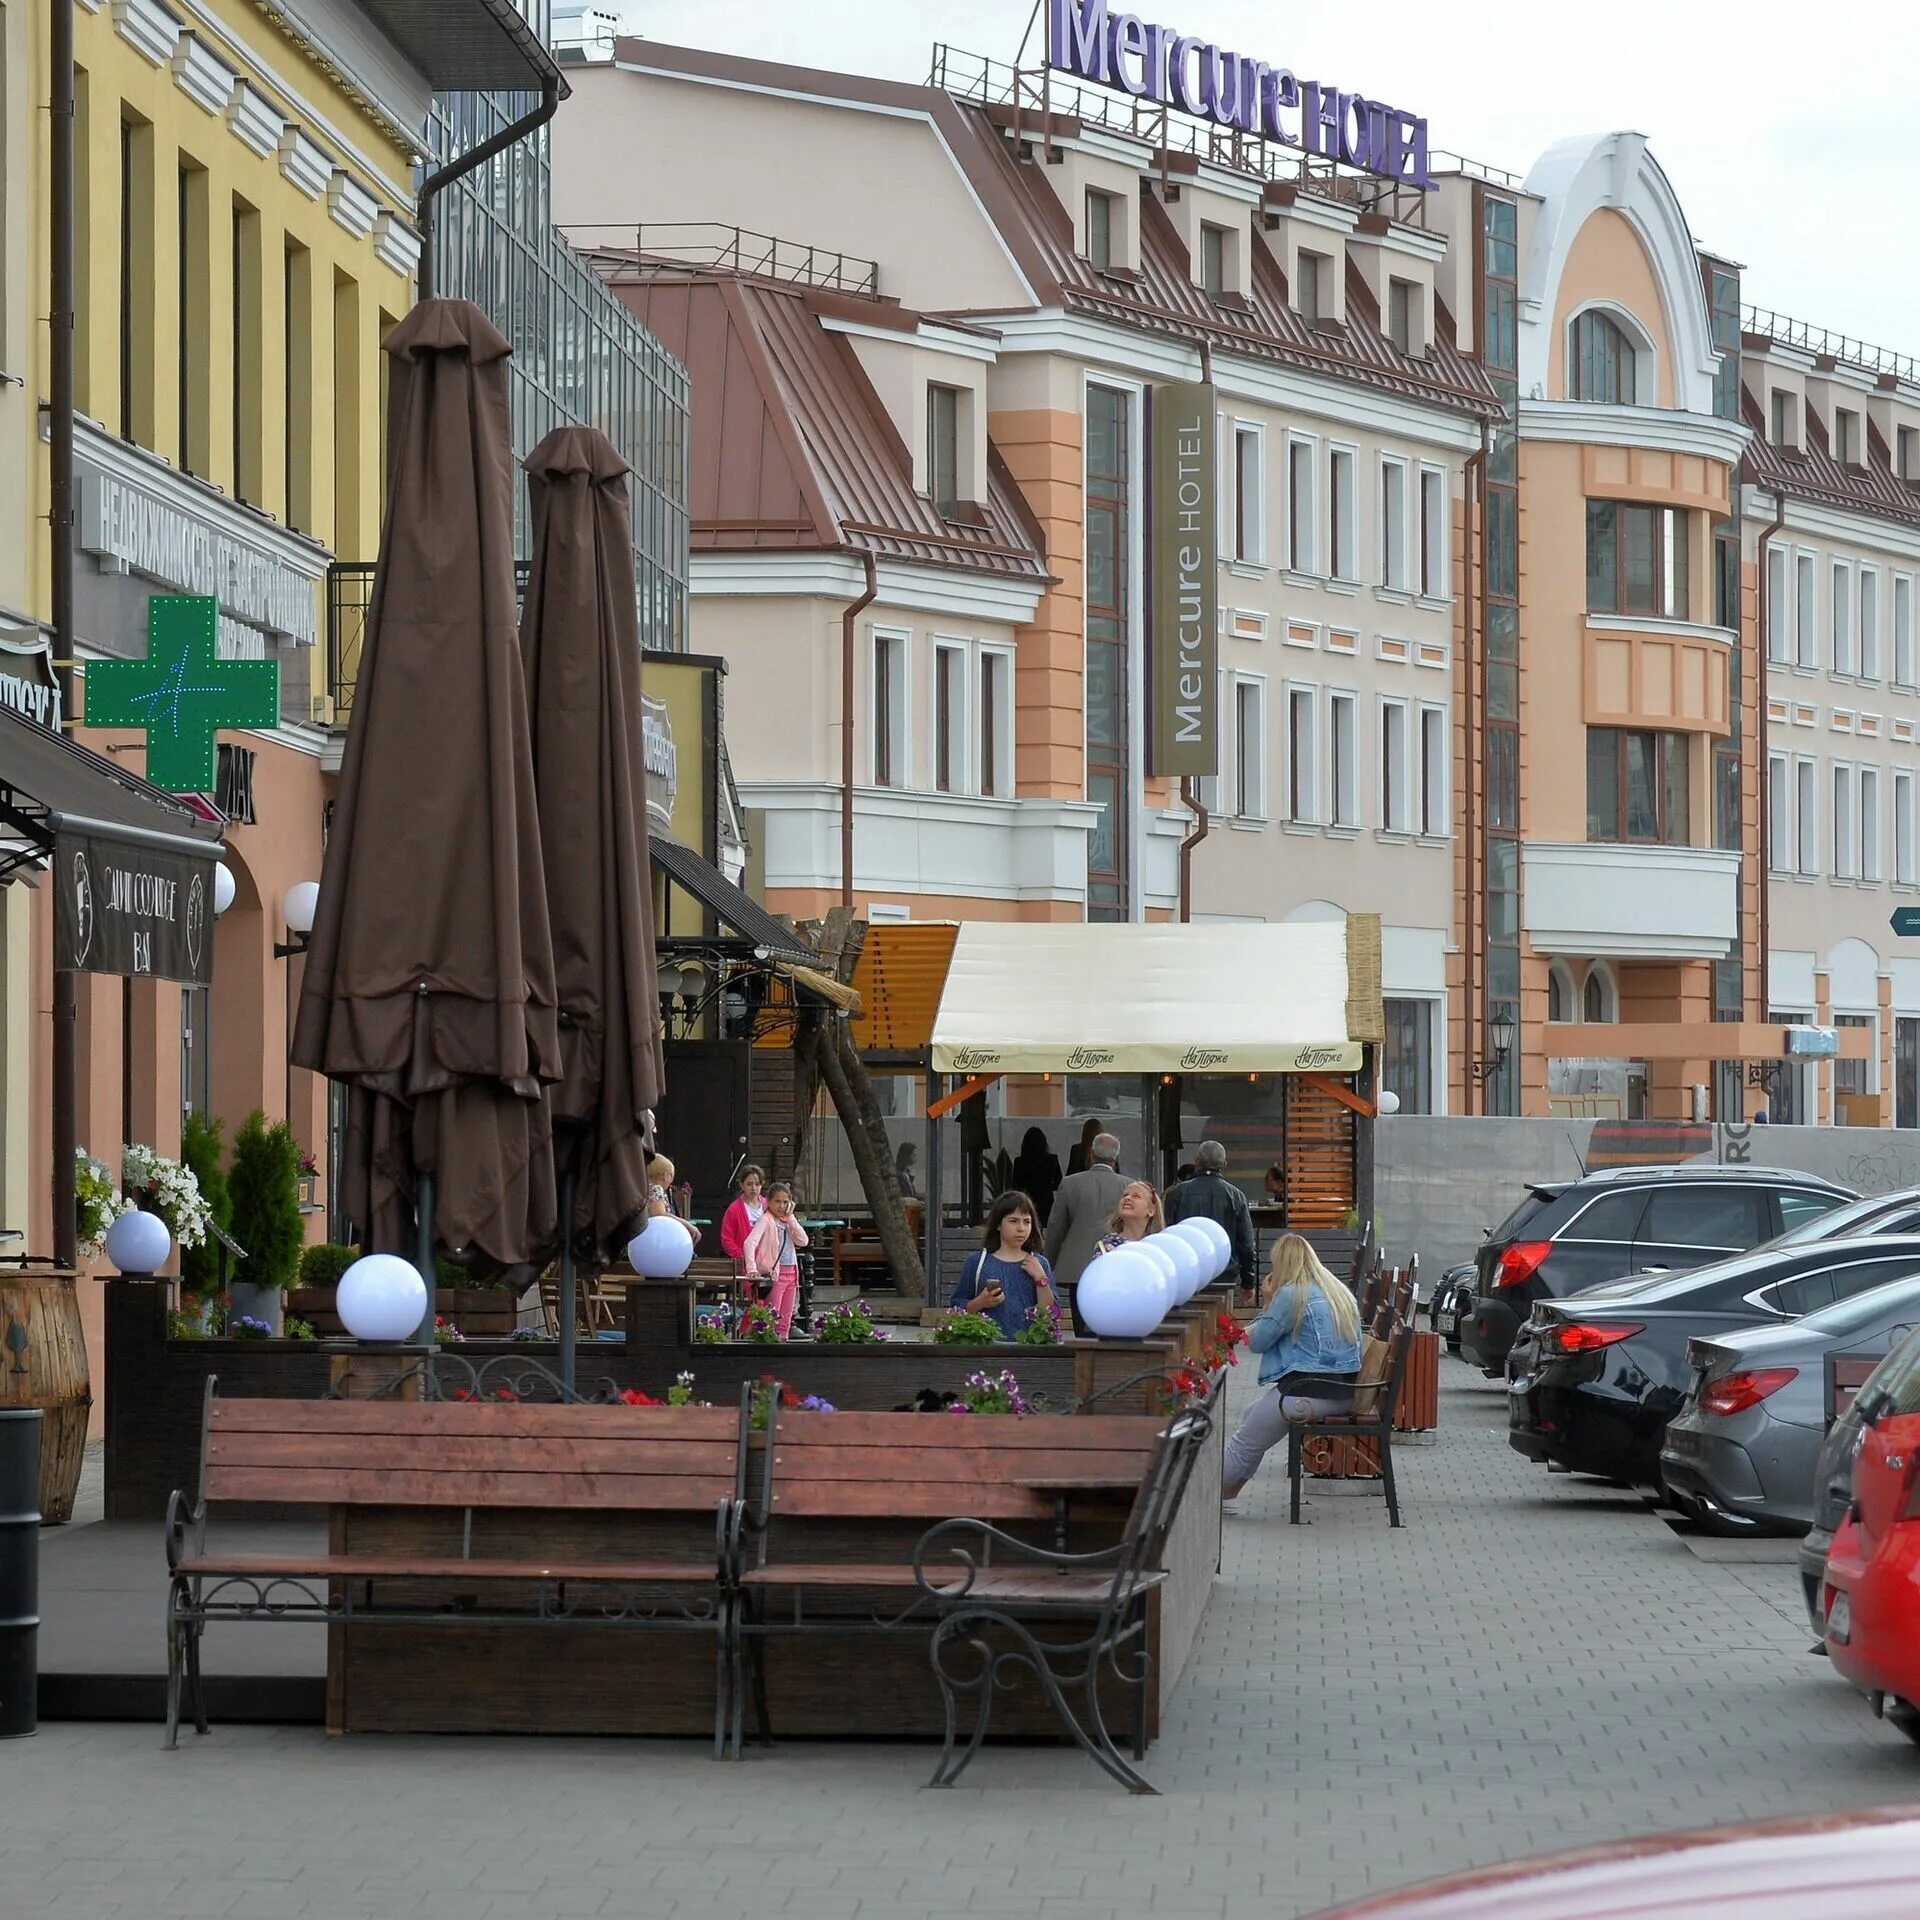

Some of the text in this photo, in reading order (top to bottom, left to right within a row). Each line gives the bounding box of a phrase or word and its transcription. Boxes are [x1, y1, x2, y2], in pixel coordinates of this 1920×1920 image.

[1051, 0, 1299, 144] Mercure
[98, 475, 214, 595] НЕДВИЖИМОСТЬ
[1174, 414, 1202, 743] Mercure HOTEL
